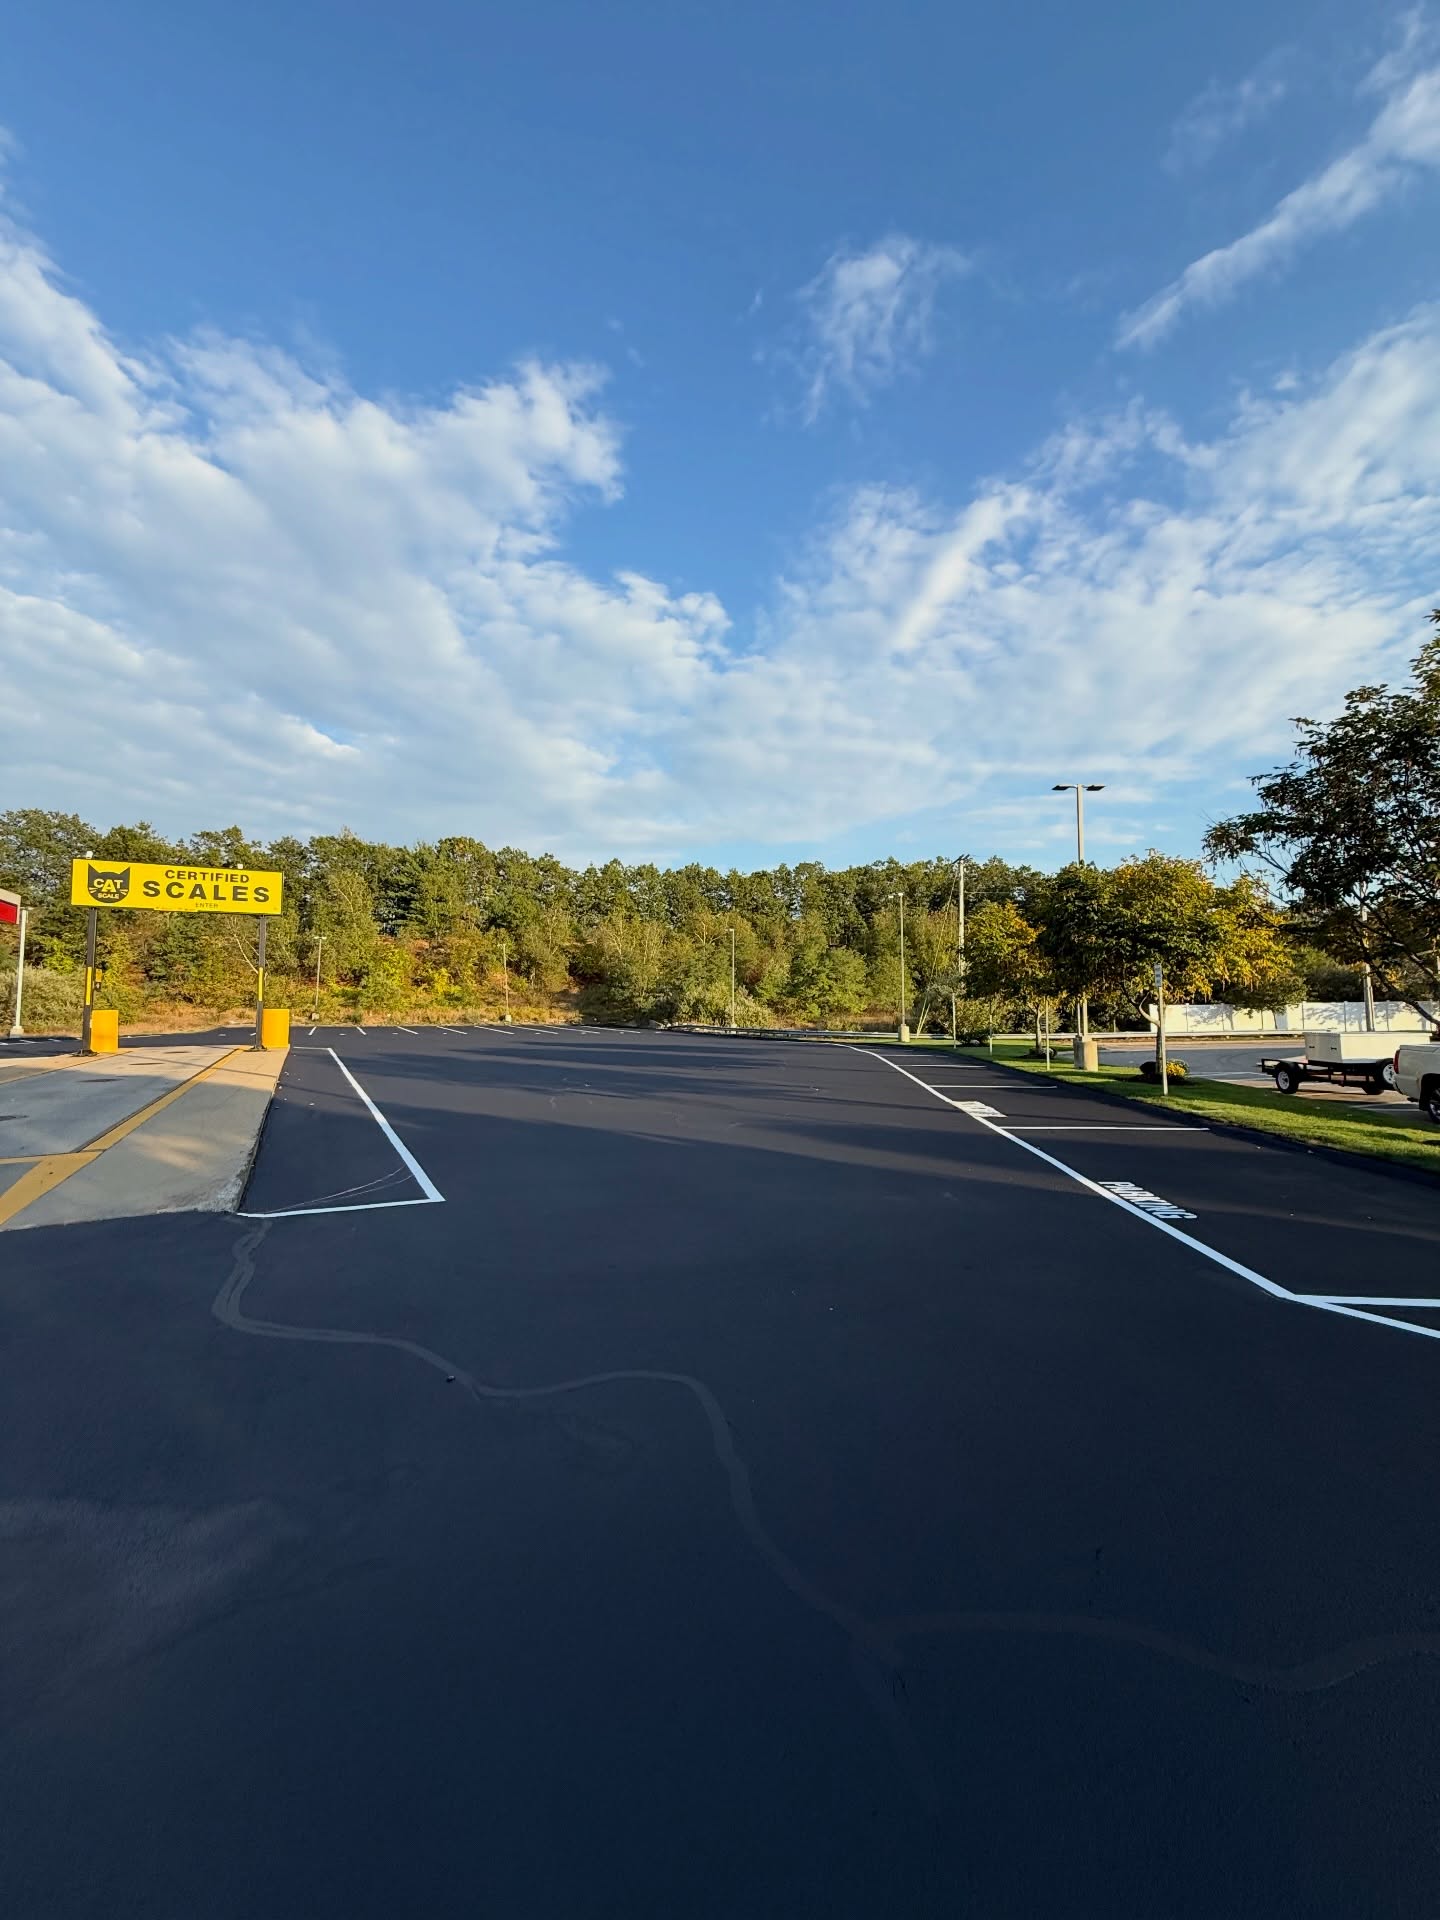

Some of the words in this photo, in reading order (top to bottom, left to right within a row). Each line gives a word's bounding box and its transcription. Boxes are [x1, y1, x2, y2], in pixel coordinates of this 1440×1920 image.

[93, 878, 124, 893] CAT
[164, 869, 250, 883] CERTIFIED
[142, 880, 270, 903] SCALES
[1097, 1181, 1198, 1219] PARKING
